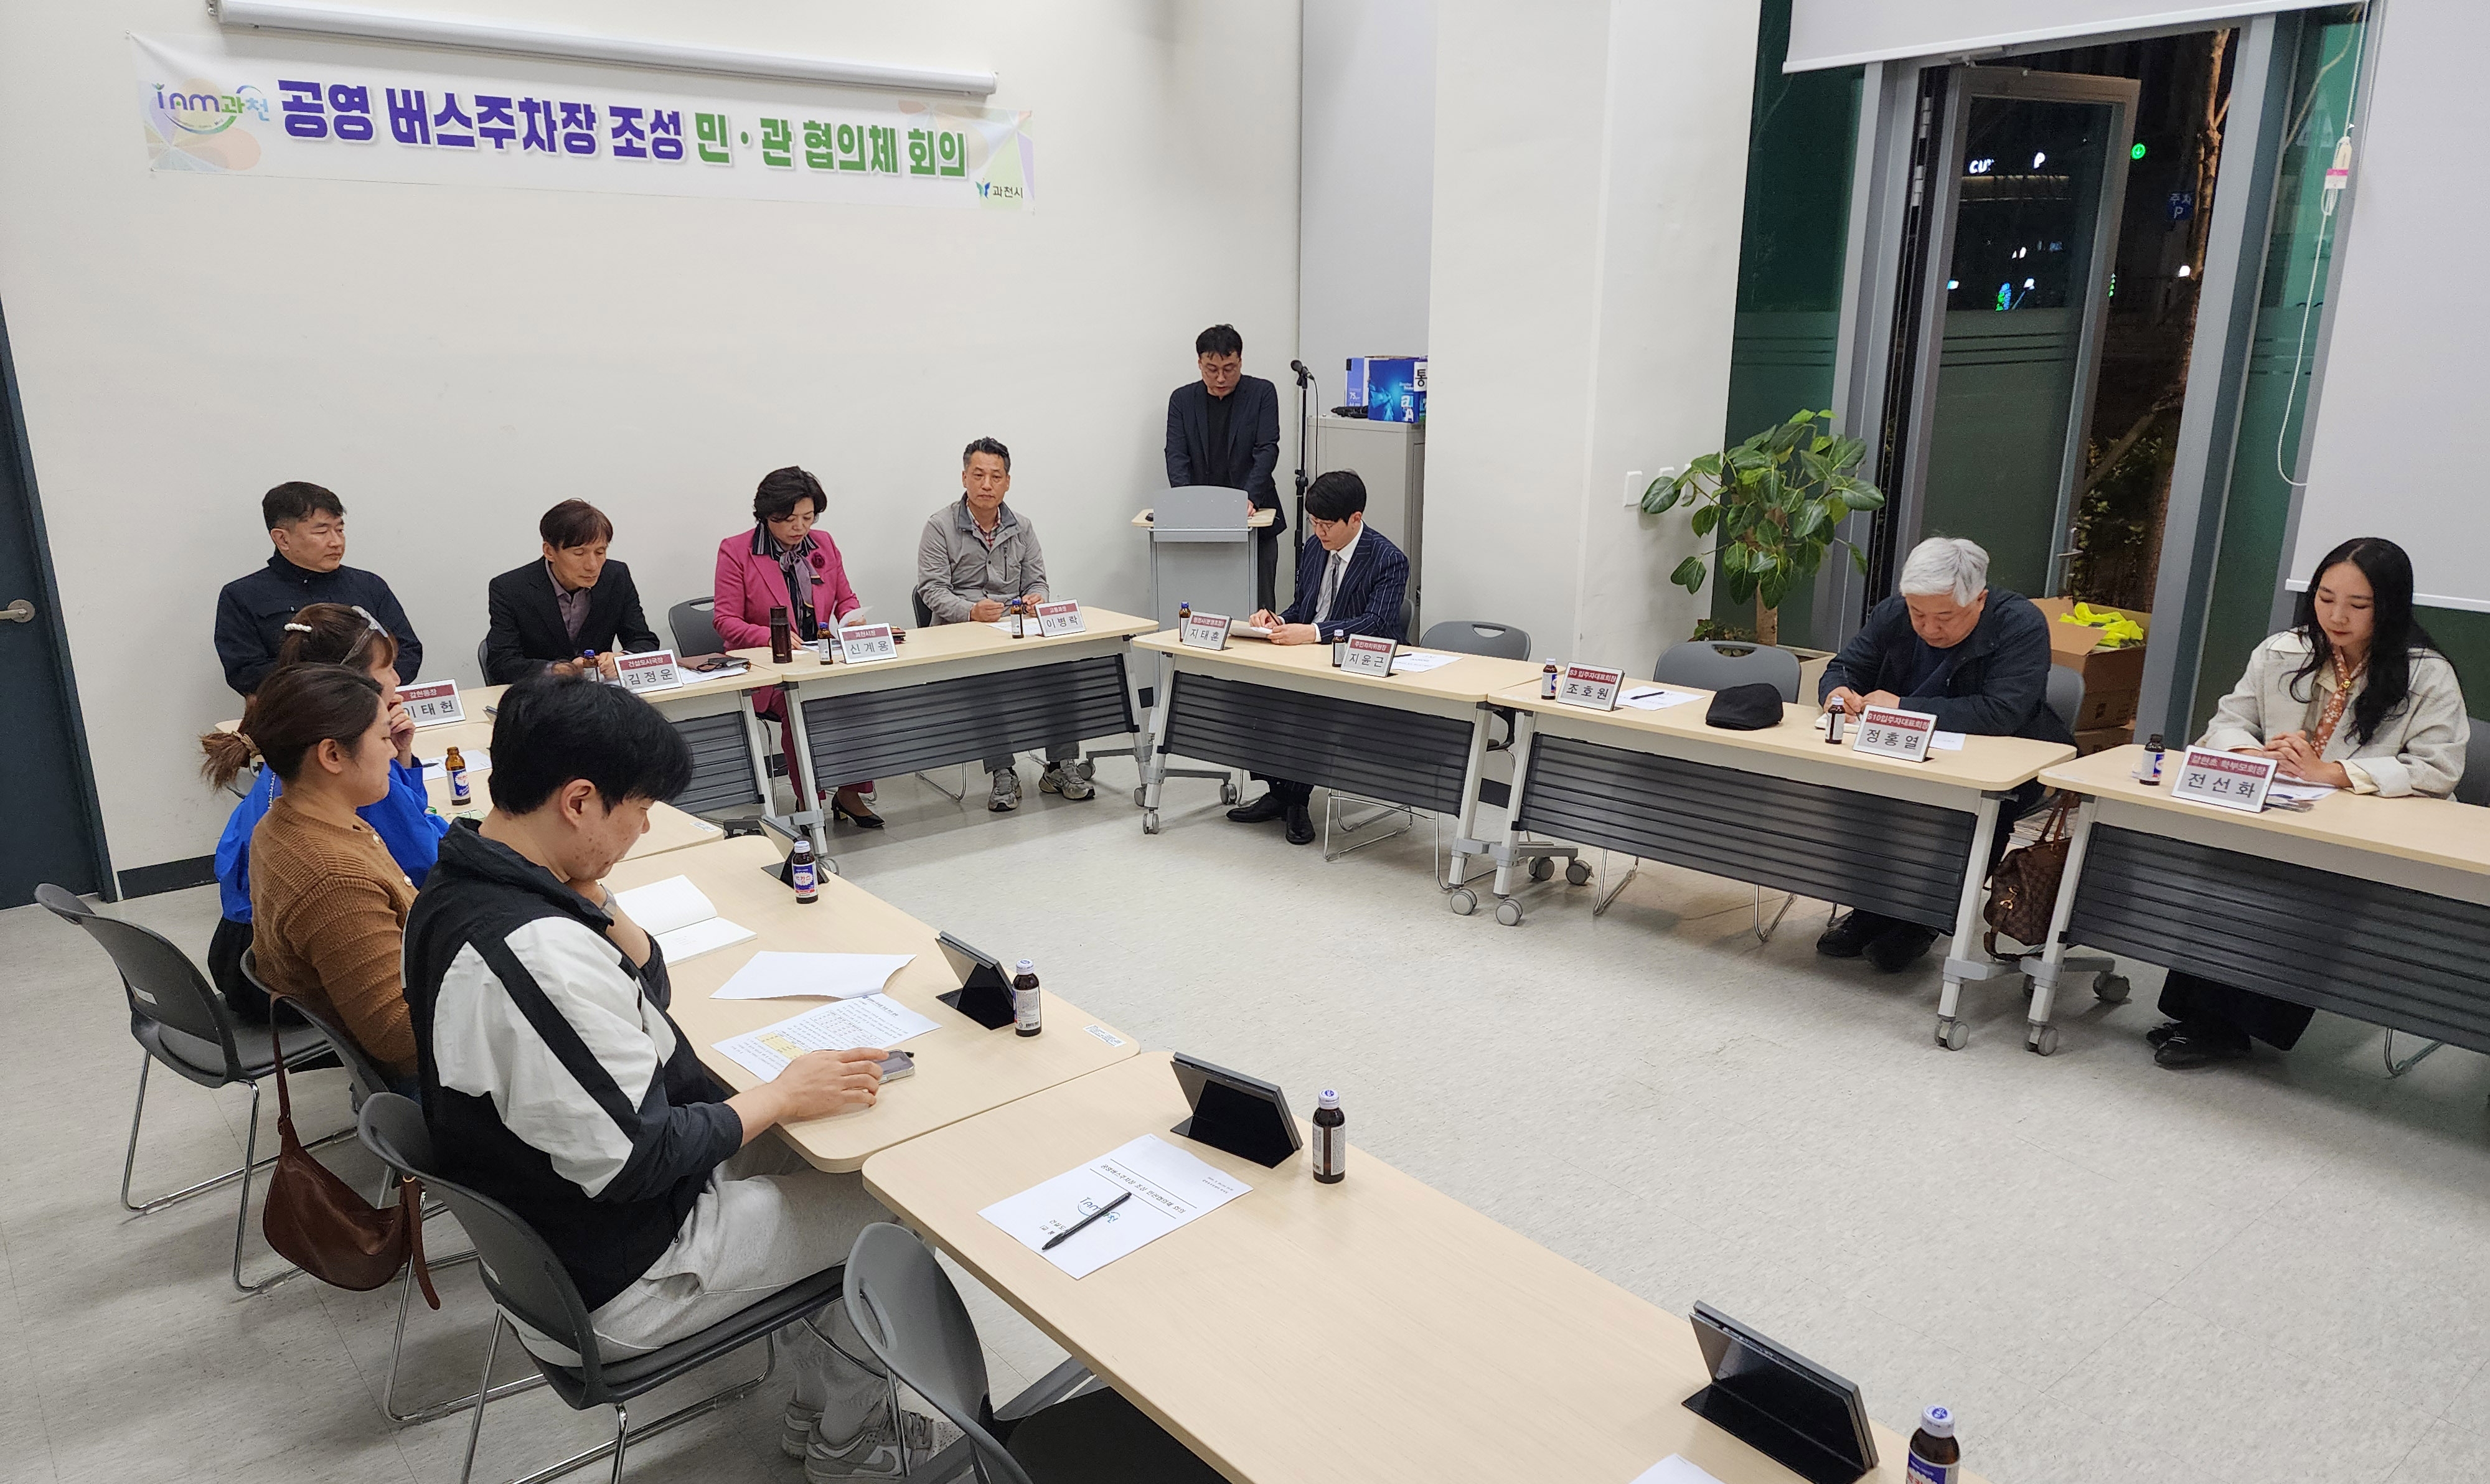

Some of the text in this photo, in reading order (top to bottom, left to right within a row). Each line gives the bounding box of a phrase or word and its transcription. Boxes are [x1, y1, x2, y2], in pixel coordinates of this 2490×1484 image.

[278, 80, 374, 141] 공영
[386, 87, 597, 155] 버스주차장
[609, 106, 683, 160] 조성
[804, 120, 898, 172] 협의체
[908, 129, 964, 177] 회의
[993, 186, 1023, 199] 과천시
[2173, 206, 2184, 218] P
[850, 641, 888, 655] 신계용
[628, 657, 664, 668] 건설도시국장
[1349, 653, 1384, 668] 지윤근
[627, 669, 673, 685] 김정운
[1566, 683, 1609, 700] 조호원
[1867, 729, 1919, 750] 정홍열
[2188, 772, 2255, 798] 전선화
